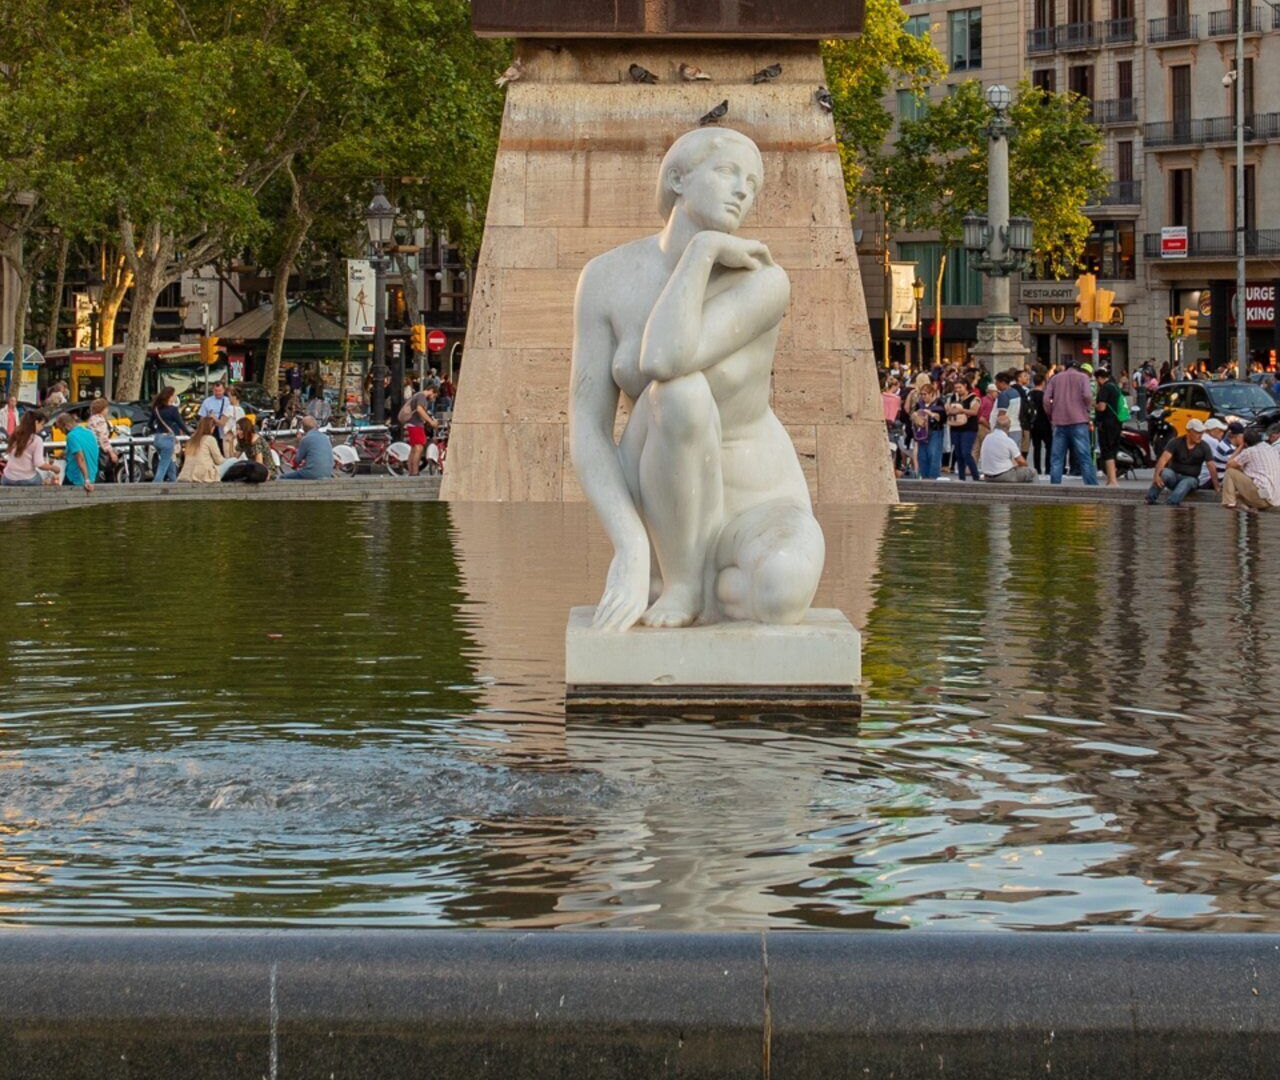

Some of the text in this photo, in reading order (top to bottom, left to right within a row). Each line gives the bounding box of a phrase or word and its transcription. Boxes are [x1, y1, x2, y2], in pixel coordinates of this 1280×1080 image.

[1245, 286, 1276, 301] URGE
[1029, 306, 1124, 325] NUA
[1246, 307, 1276, 321] KING
